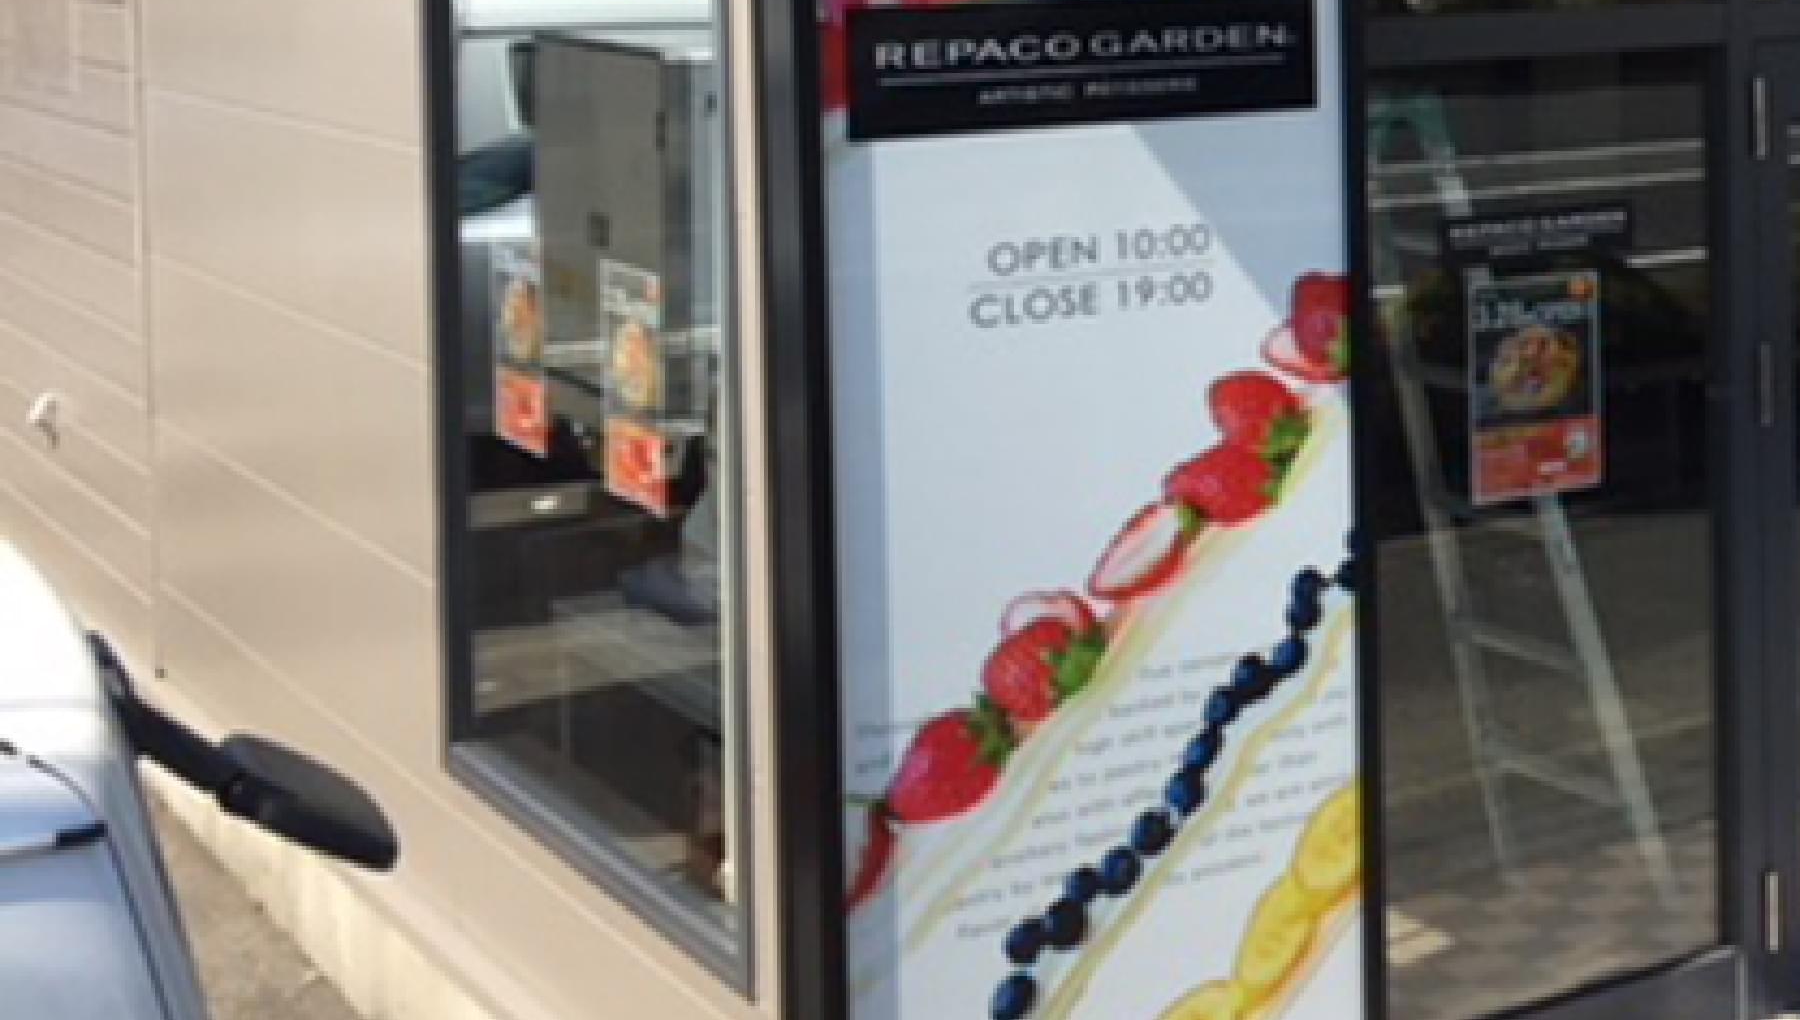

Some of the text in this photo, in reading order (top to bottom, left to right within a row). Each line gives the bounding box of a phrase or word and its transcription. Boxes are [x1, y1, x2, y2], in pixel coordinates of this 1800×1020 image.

[874, 31, 1079, 69] REPACO
[987, 223, 1210, 277] OPEN 10:00
[969, 272, 1212, 328] CLOSE 19:00
